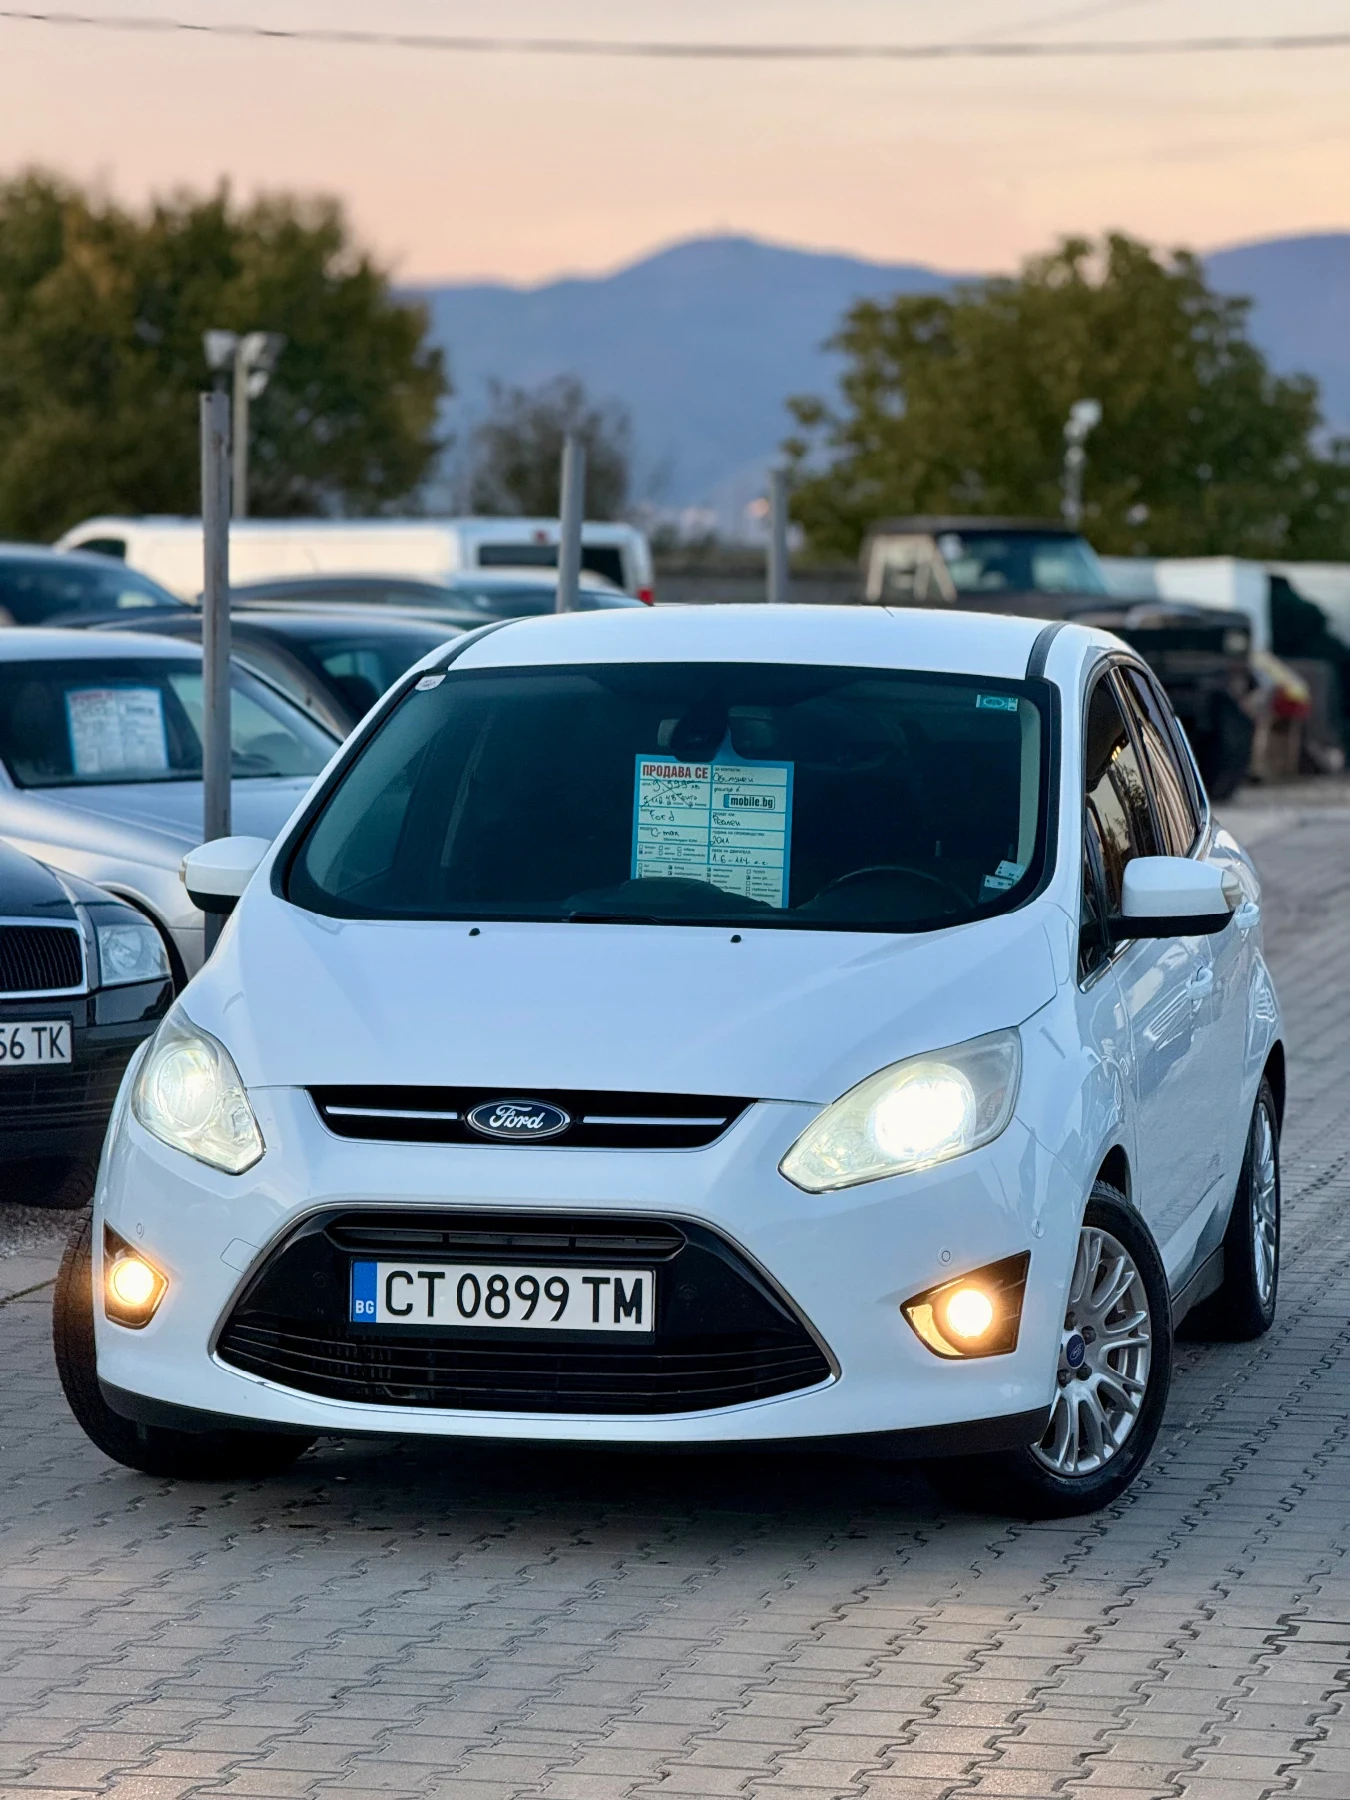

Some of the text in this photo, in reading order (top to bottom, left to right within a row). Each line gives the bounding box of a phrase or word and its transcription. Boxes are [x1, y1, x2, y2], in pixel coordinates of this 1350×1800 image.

[643, 764, 709, 779] ПРОДАВА СЕ
[730, 797, 773, 809] mobile.bg
[649, 809, 675, 821] Ford
[31, 1026, 65, 1059] TK
[489, 1104, 546, 1129] Ford
[385, 1270, 643, 1324] CT 0899 TM
[354, 1300, 375, 1314] BG
